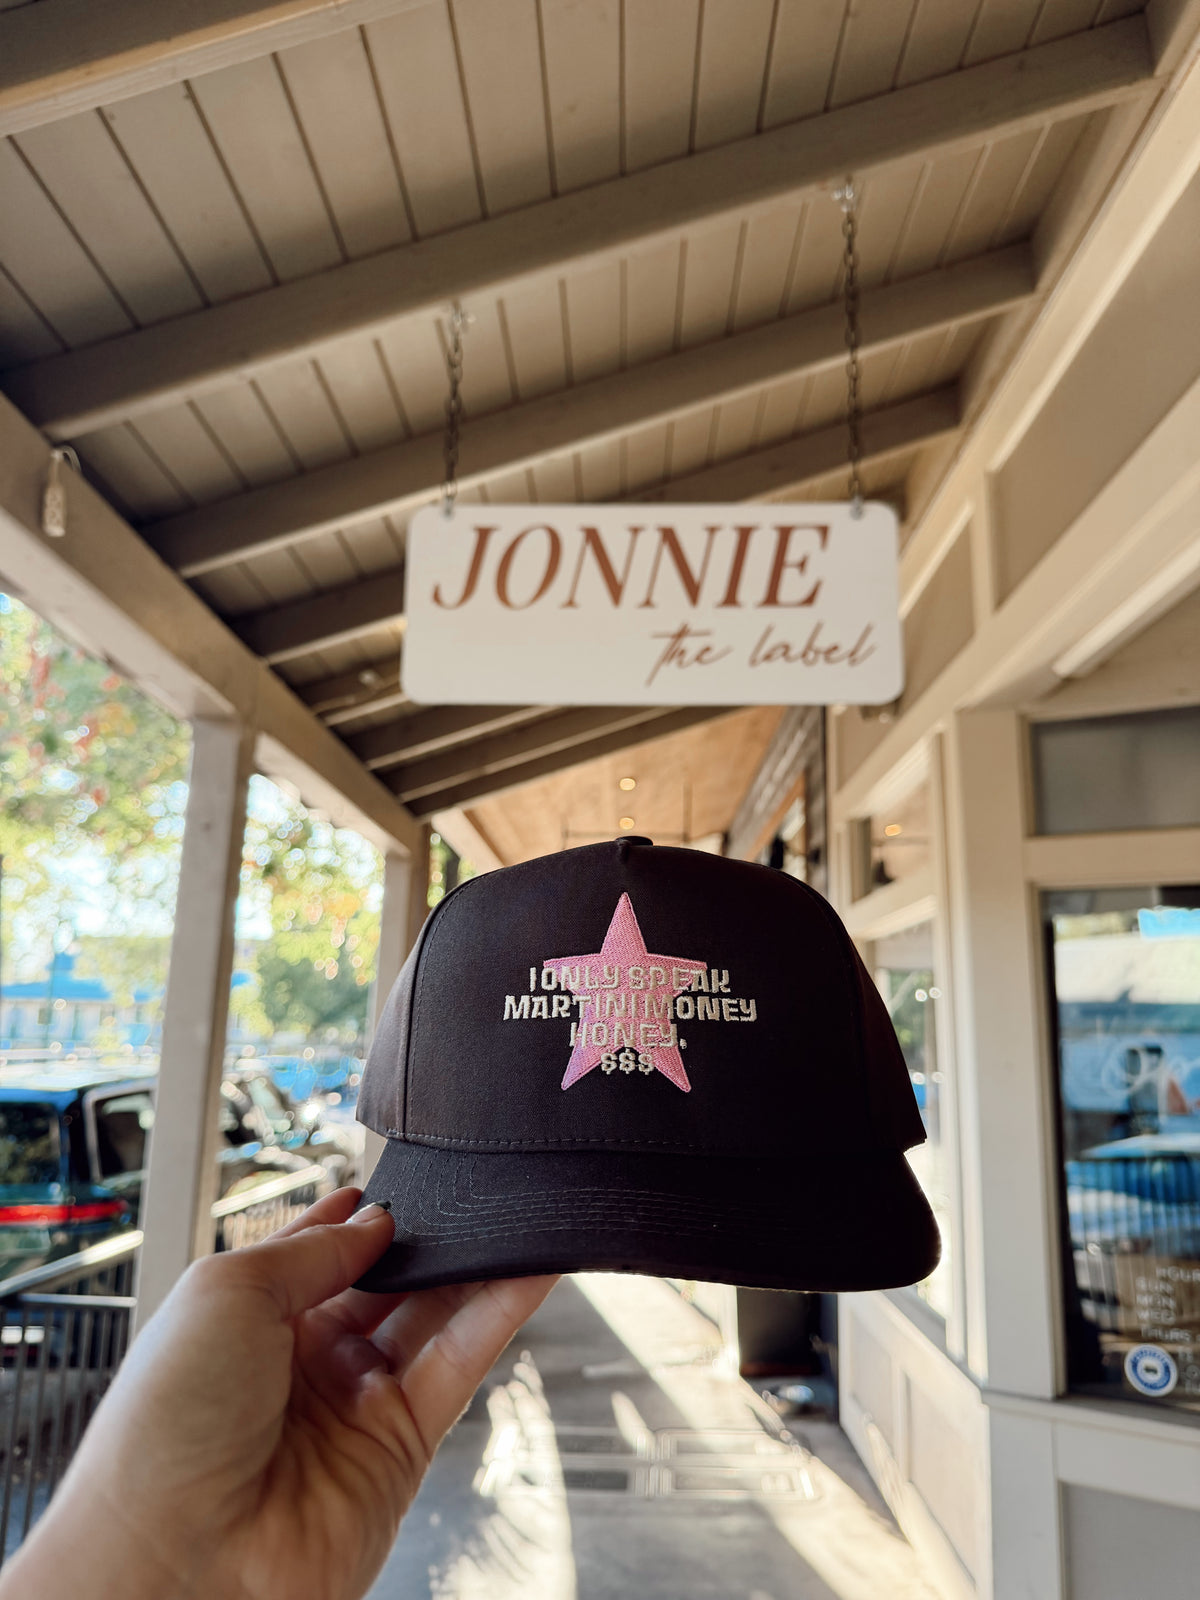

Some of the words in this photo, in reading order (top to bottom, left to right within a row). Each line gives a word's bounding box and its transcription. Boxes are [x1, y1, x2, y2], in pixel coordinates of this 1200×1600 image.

[432, 525, 831, 610] JONNIE
[645, 622, 734, 688] the
[748, 621, 874, 668] label
[530, 967, 537, 992] I
[541, 966, 620, 991] ONLY
[628, 967, 731, 993] SPEAK
[503, 995, 640, 1020] MARTINI
[645, 997, 757, 1022] MONEY
[569, 1022, 687, 1049] HONEY.
[600, 1049, 655, 1075] $$$
